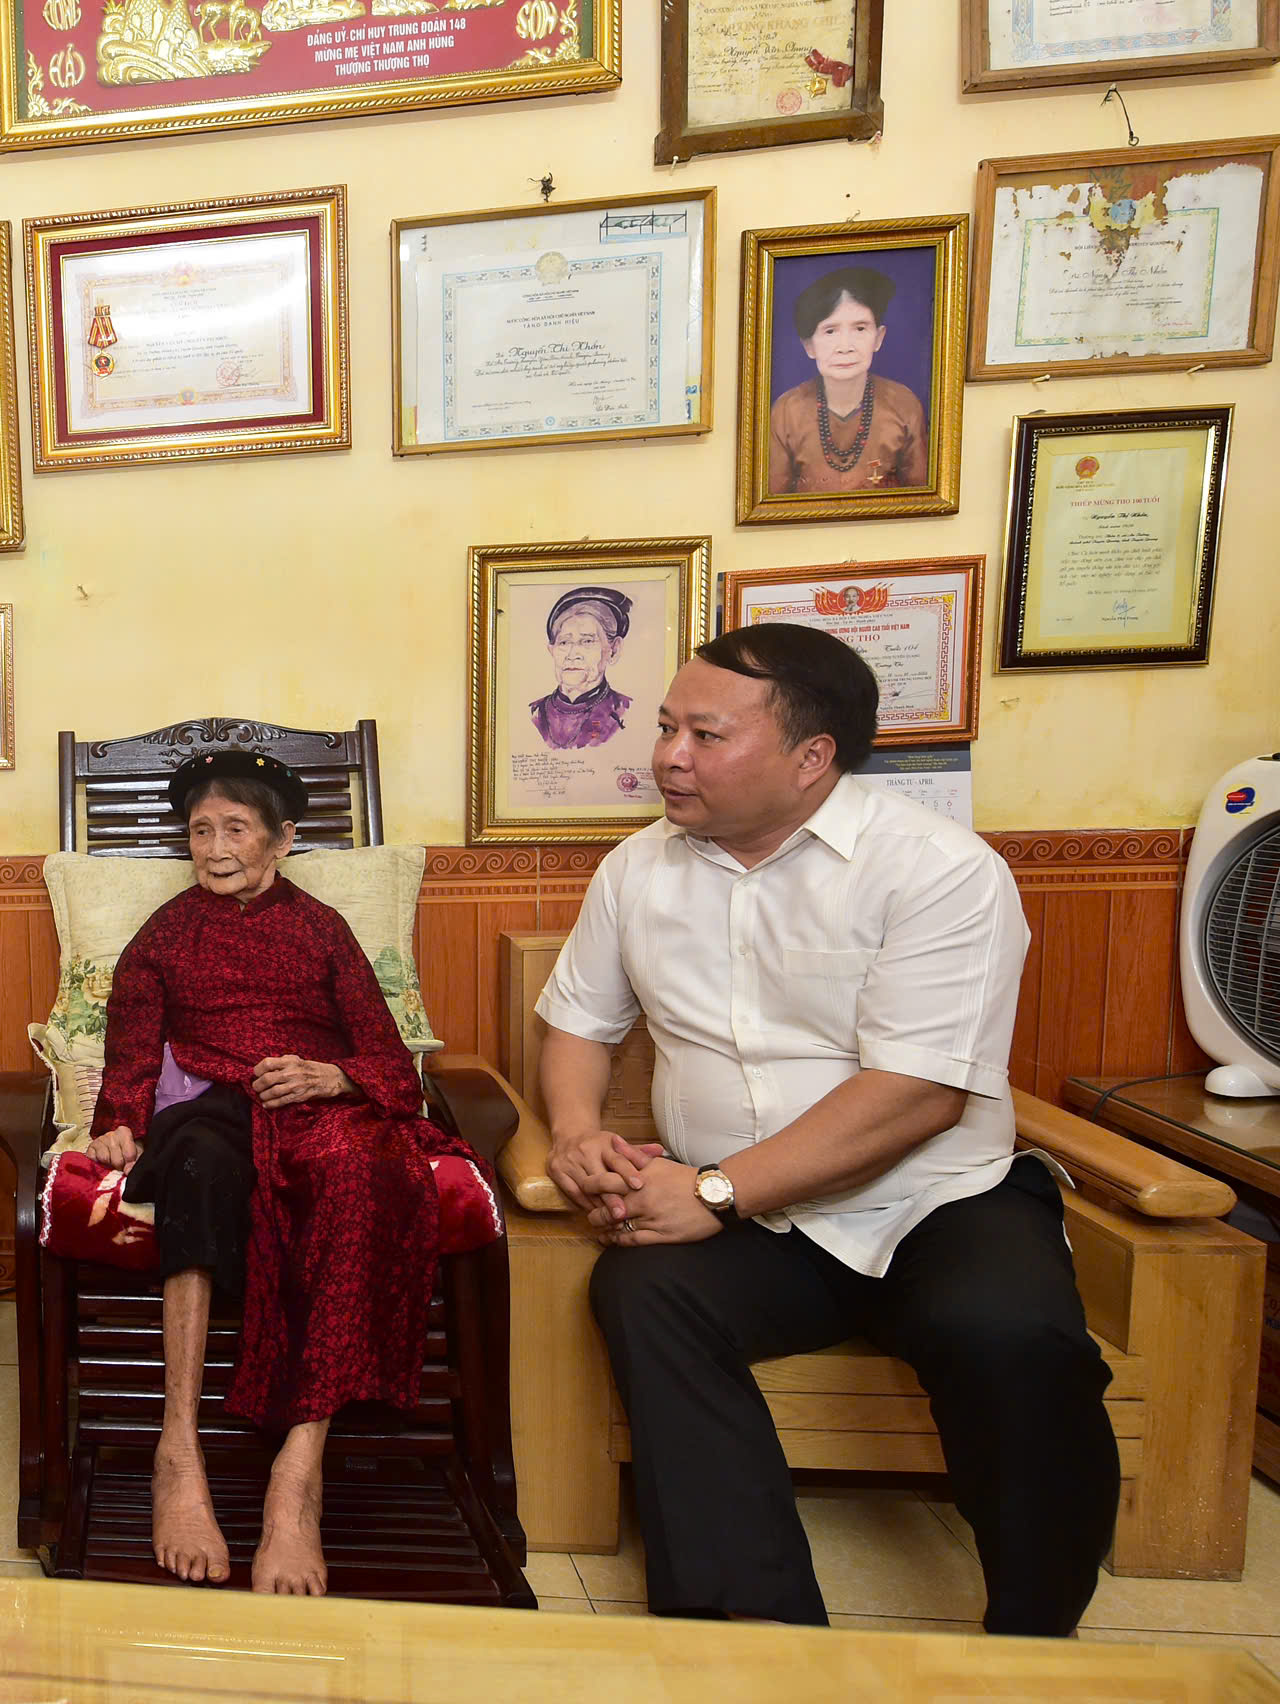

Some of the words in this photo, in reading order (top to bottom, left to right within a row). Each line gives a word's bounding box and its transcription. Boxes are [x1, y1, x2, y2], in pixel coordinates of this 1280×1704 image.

[307, 29, 332, 46] ĐẢNG
[350, 24, 366, 41] CHỈ
[368, 26, 385, 39] HUY
[388, 23, 418, 37] TRUNG
[421, 17, 447, 33] ĐOÀN
[449, 17, 466, 30] 148
[315, 47, 342, 62] MỪNG
[344, 46, 358, 60] MẸ
[361, 42, 380, 58] VIỆT
[382, 41, 404, 55] NAM
[407, 38, 426, 51] ANH
[428, 34, 454, 49] HÙNG
[335, 60, 371, 76] THƯỢNG
[373, 56, 410, 72] THƯỢNG
[412, 54, 430, 68] THỌ
